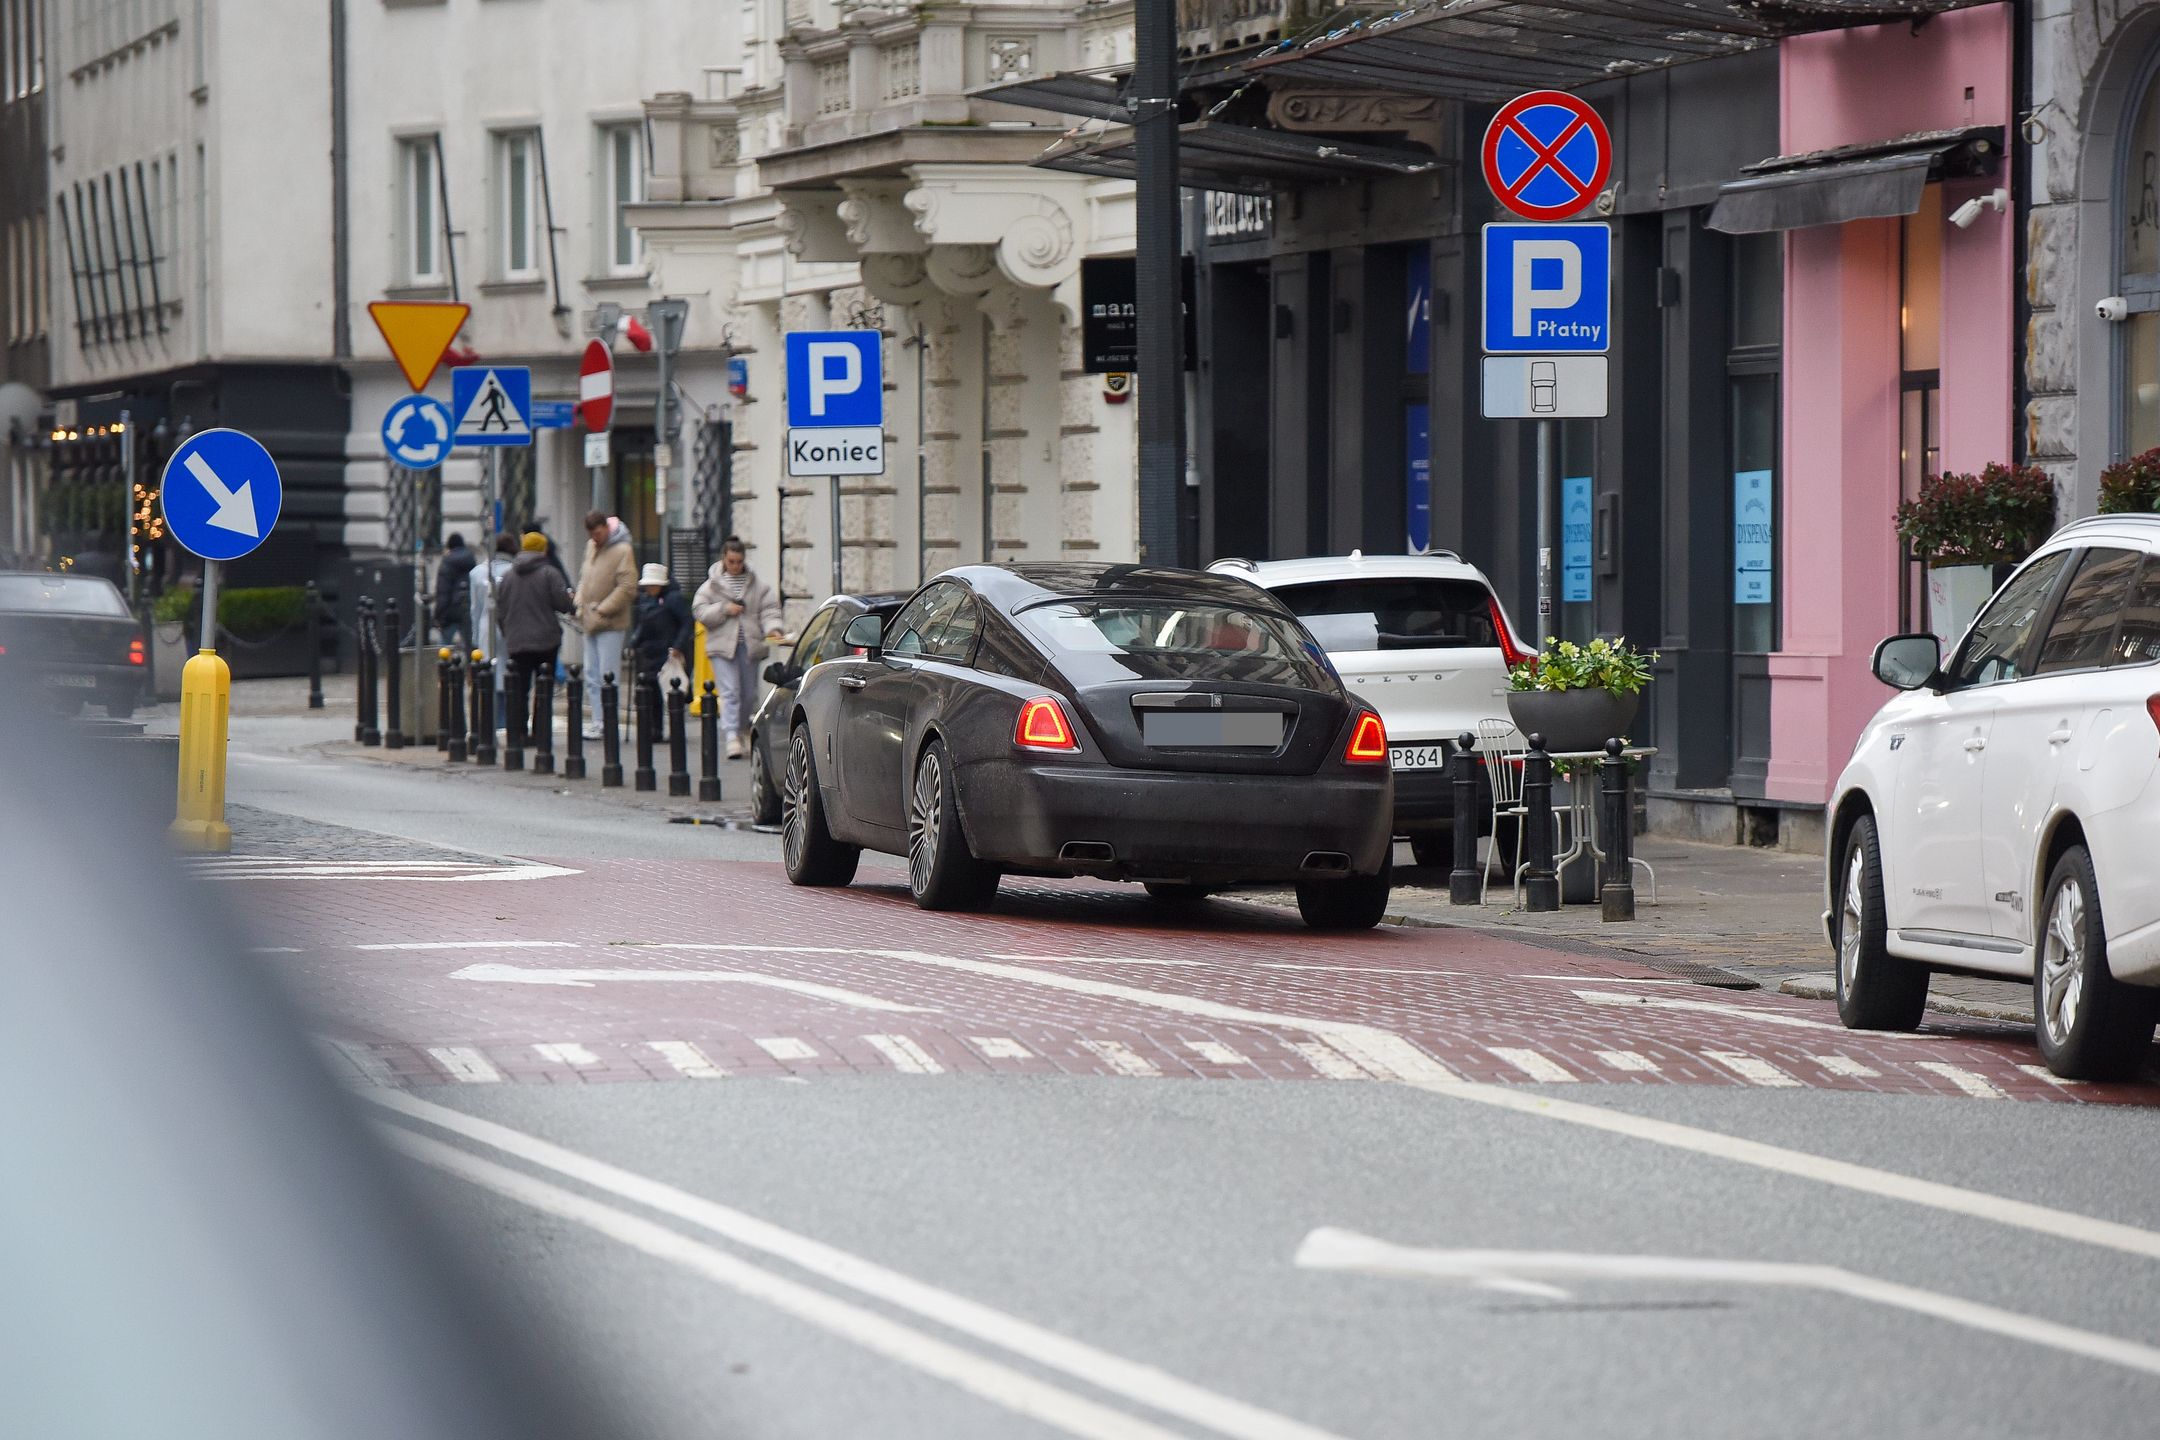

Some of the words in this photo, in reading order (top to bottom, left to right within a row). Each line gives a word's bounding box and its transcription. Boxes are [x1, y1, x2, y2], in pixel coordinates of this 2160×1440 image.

[1512, 239, 1582, 337] P
[1537, 321, 1601, 342] Płatny
[808, 341, 862, 416] P
[794, 439, 878, 462] Koniec
[1357, 674, 1442, 683] OLVO
